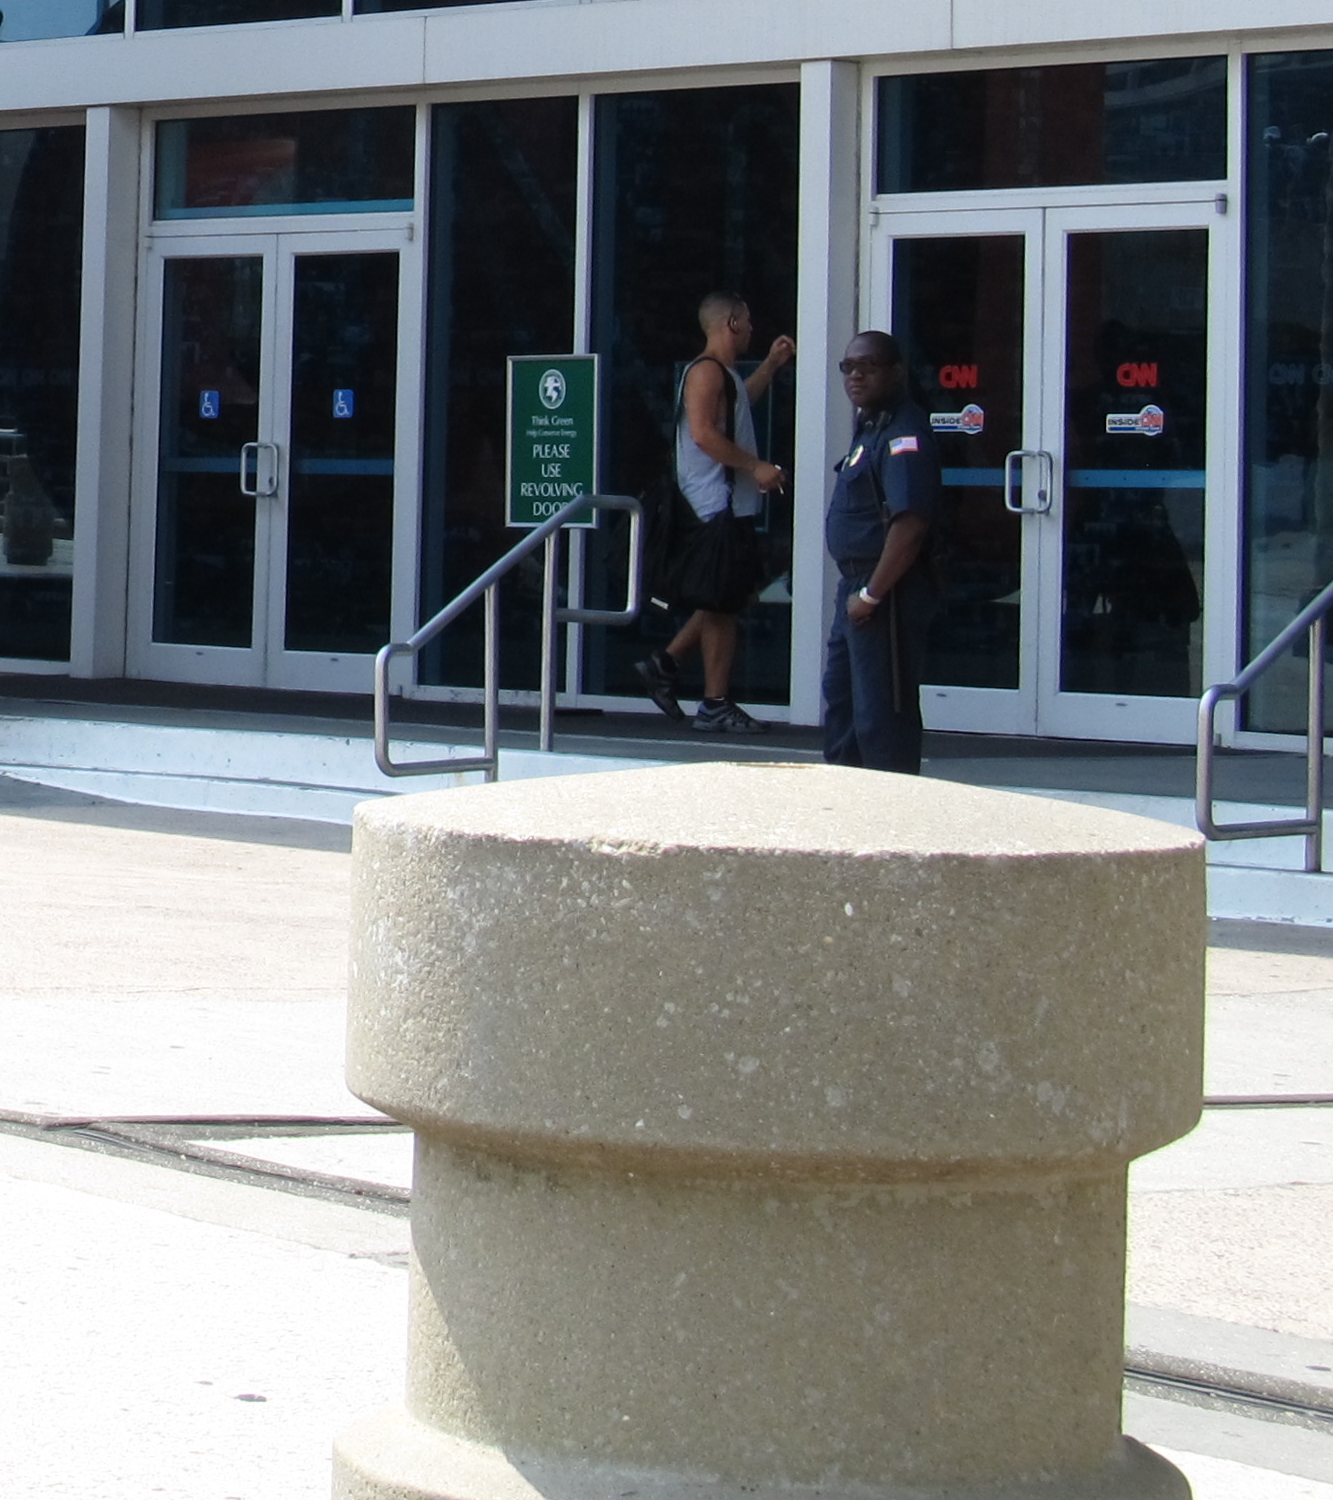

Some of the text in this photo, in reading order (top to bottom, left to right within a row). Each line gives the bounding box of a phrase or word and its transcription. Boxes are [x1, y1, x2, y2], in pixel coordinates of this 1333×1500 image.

[939, 364, 978, 388] CNN
[1117, 363, 1159, 387] CNN
[532, 414, 574, 426] Think Green
[931, 416, 962, 425] INSIDE
[1108, 417, 1141, 426] INSIDE
[533, 444, 570, 458] PLEASE
[541, 464, 561, 477] USE
[520, 482, 583, 497] REVOLVING
[532, 501, 570, 516] DOO
